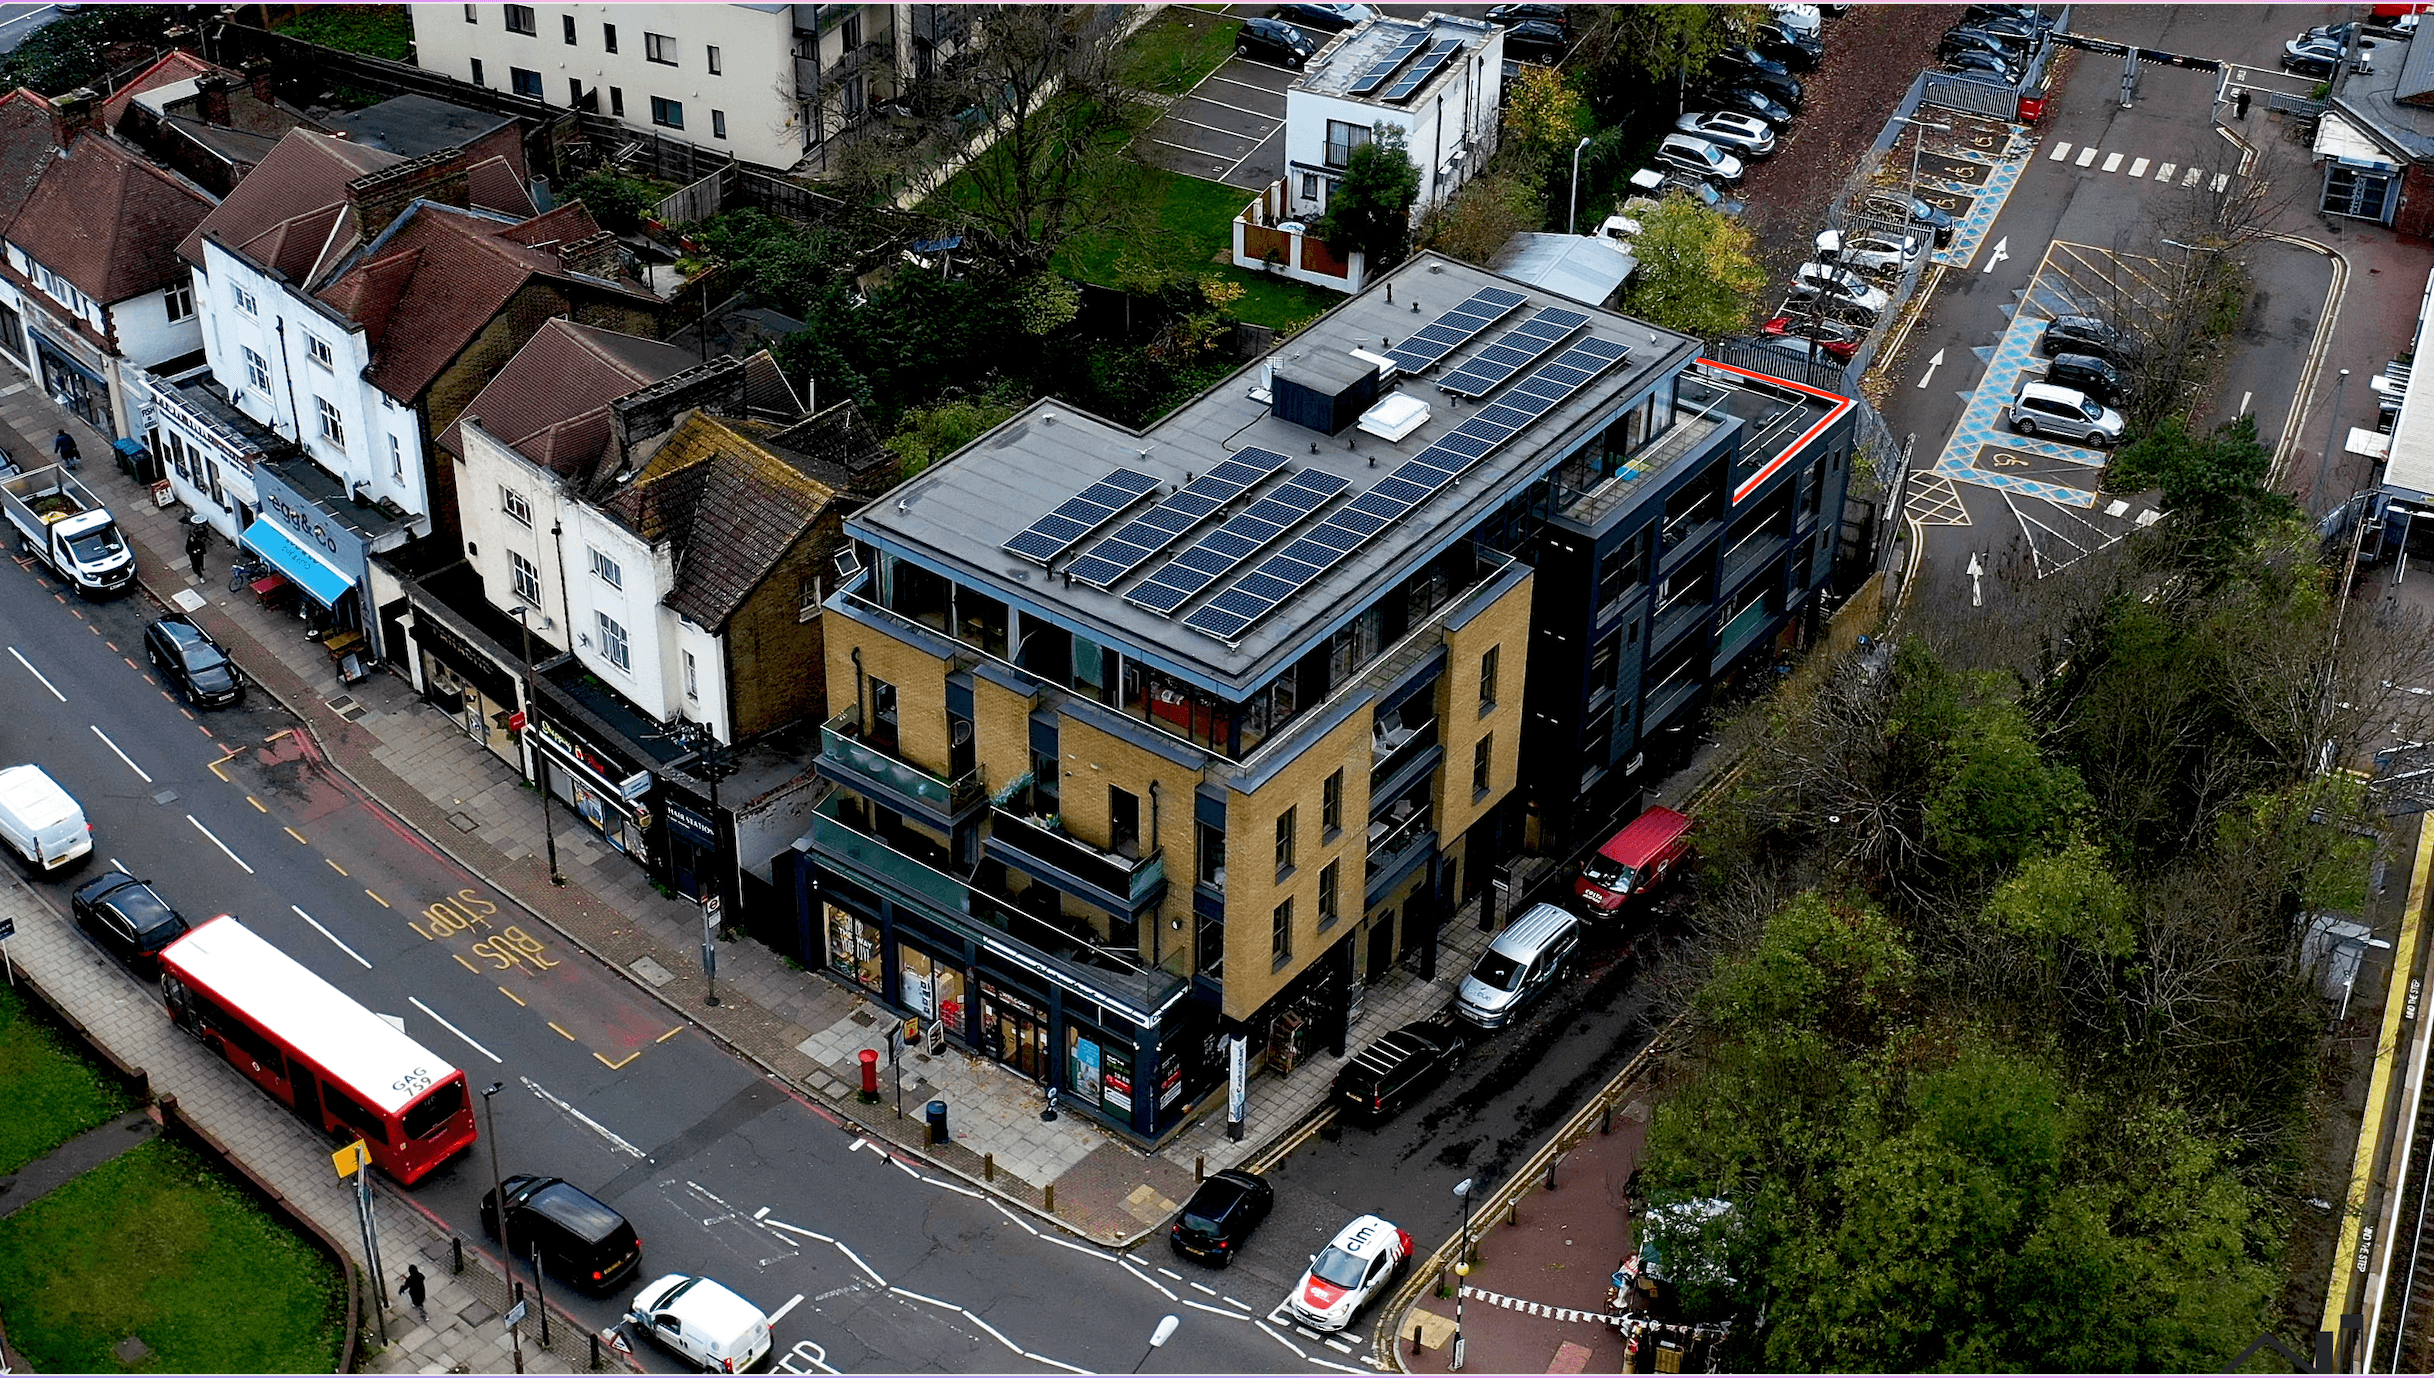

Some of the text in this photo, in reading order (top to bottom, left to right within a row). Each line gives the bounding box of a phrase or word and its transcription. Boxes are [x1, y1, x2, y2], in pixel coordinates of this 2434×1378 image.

[421, 888, 498, 938] STOP
[471, 925, 549, 971] BUS
[392, 1066, 427, 1091] GAG
[403, 1076, 432, 1097] 759
